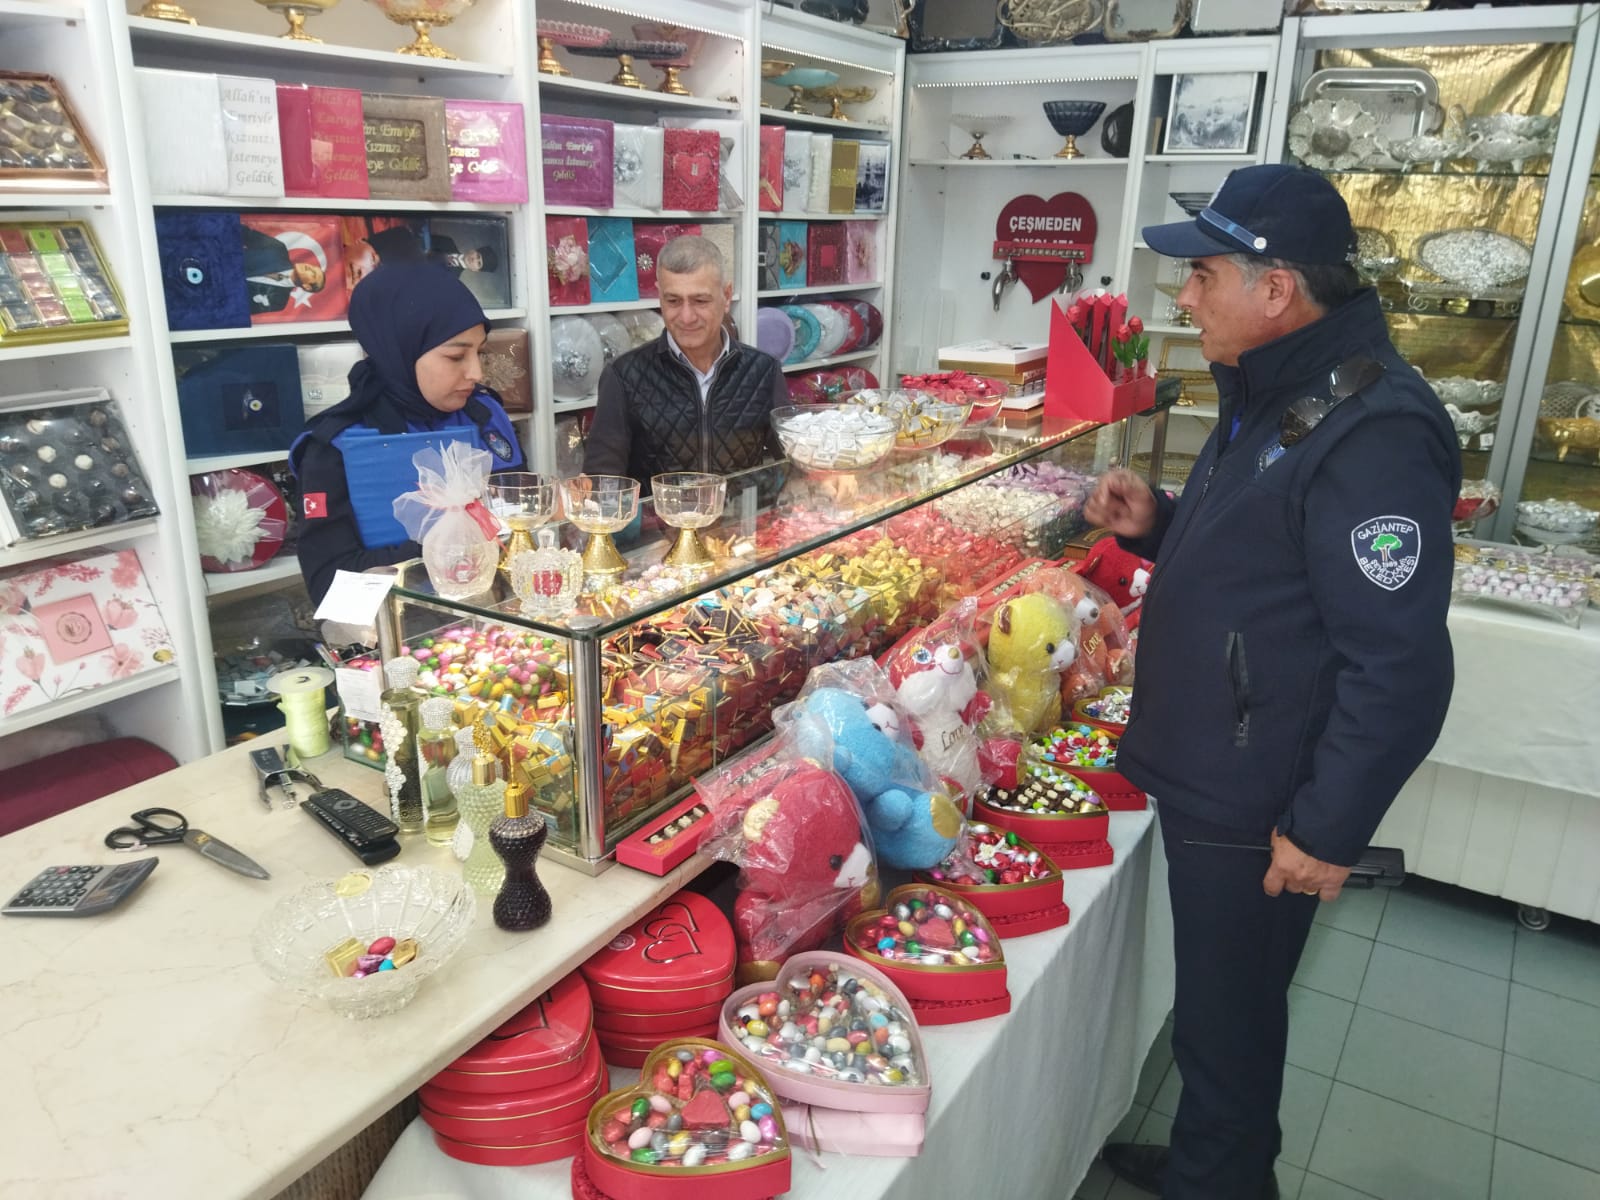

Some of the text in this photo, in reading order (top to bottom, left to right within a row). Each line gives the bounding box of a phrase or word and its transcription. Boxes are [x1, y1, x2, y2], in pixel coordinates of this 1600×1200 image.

[236, 168, 278, 186] Geldik
[1009, 216, 1082, 233] ÇEŞMEDEN
[1357, 521, 1414, 540] GAZİANTEP
